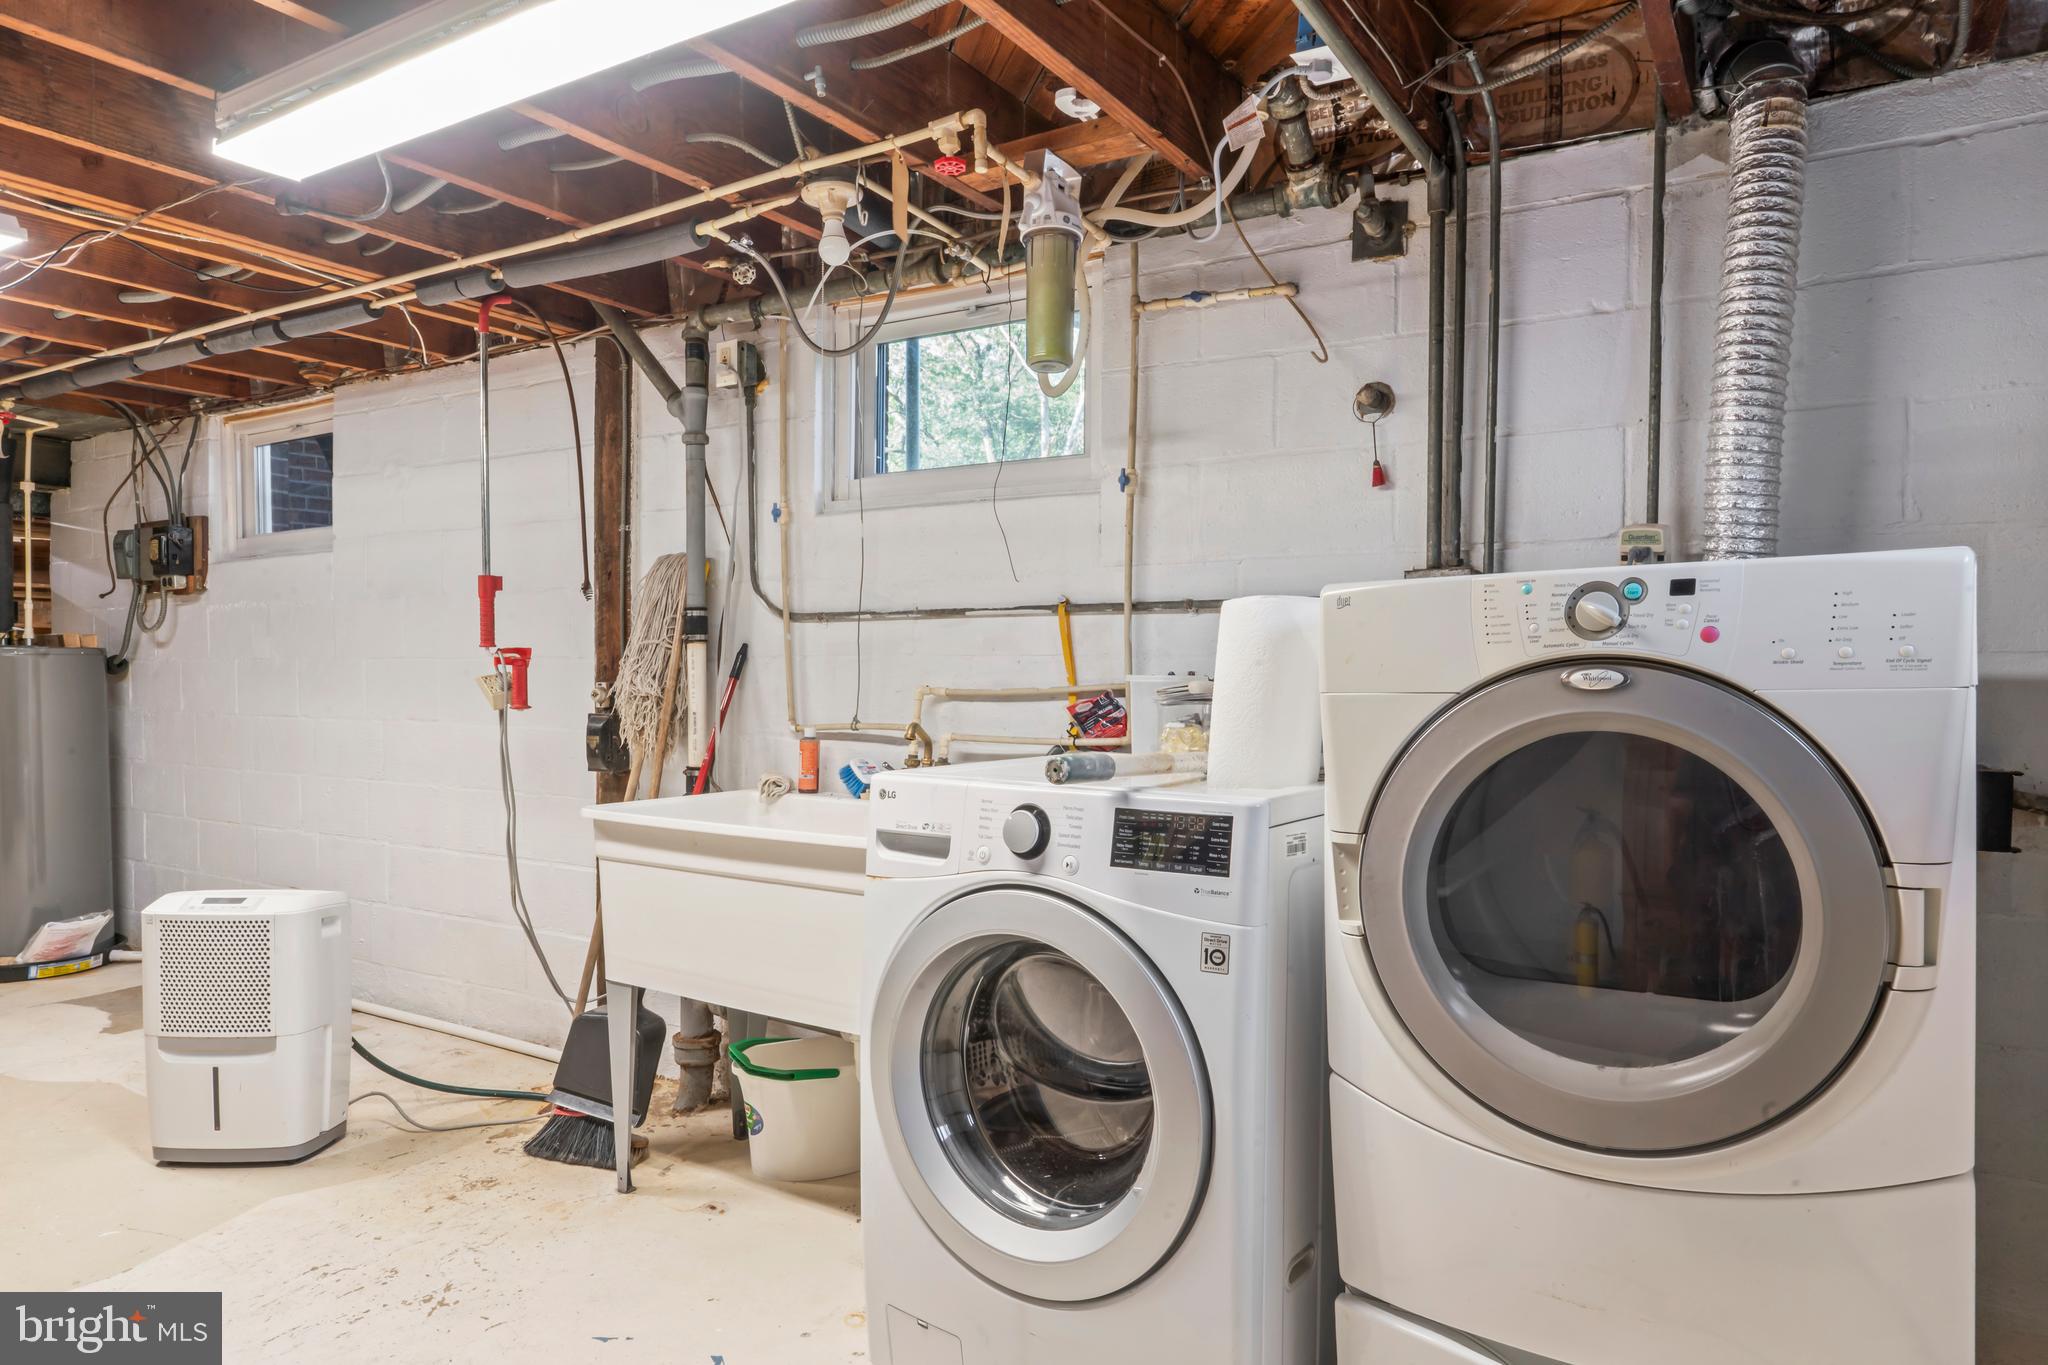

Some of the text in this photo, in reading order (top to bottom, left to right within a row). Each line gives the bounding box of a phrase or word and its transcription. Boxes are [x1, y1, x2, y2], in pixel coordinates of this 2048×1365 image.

[1498, 76, 1602, 110] BUILDING
[1582, 672, 1612, 682] Whirlpool
[887, 791, 897, 799] LG
[1200, 888, 1230, 897] TrueBalance
[1204, 947, 1226, 967] 10
